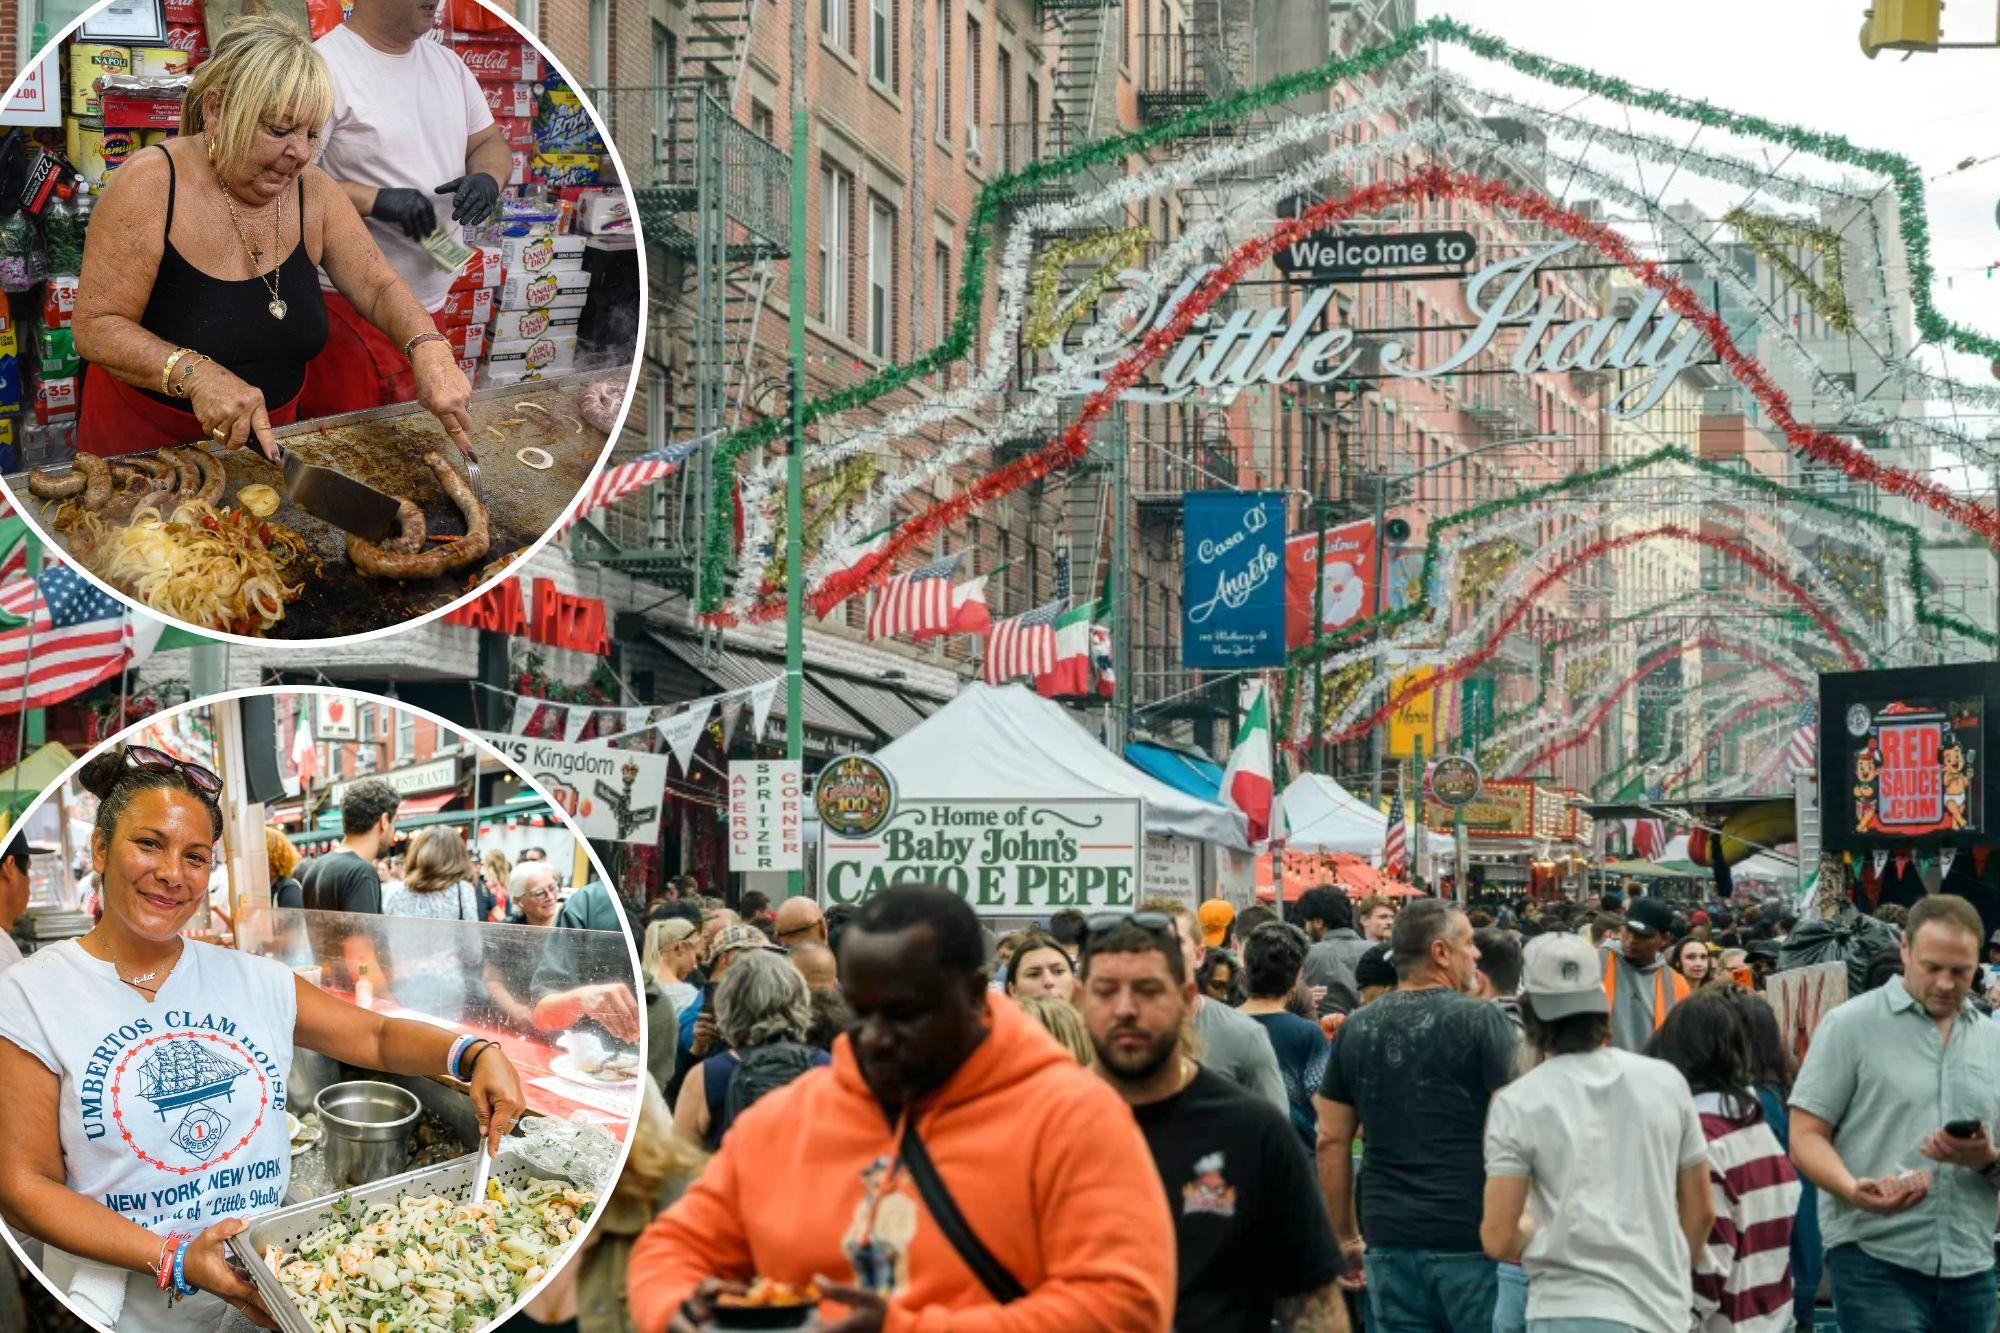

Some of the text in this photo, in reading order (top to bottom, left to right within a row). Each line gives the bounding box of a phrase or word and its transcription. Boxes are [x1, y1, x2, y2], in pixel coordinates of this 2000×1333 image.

[93, 56, 128, 67] NAPOLI
[461, 49, 511, 70] Coca-Cola
[523, 51, 536, 60] 35
[516, 91, 527, 100] 35
[32, 157, 53, 182] 222
[485, 254, 500, 265] 35
[522, 245, 554, 268] CANADA
[530, 255, 546, 268] DRY
[1290, 237, 1466, 267] Welcome to
[475, 291, 490, 302] 35
[526, 282, 558, 301] CANADA
[534, 290, 550, 304] DRY
[518, 313, 550, 333] CANADA
[526, 323, 543, 336] DRY
[1032, 240, 1704, 421] Little Italy
[460, 360, 474, 369] 35
[525, 346, 556, 364] CANADA
[48, 384, 71, 397] 35
[1197, 532, 1245, 564] Casa
[1188, 544, 1279, 623] Angelo
[442, 576, 527, 637] ASTA
[1881, 727, 1940, 769] RED
[533, 745, 615, 776] Kingdom
[1881, 769, 1940, 797] SAUCE
[733, 774, 749, 855] APEROL
[757, 763, 772, 868] SPRITZER
[782, 773, 799, 853] CORNER
[930, 805, 1028, 826] Home of
[1883, 797, 1937, 820] .COM
[883, 828, 1078, 865] Baby John's
[976, 866, 1006, 905] E
[1015, 865, 1134, 905] PEPE
[80, 1010, 285, 1141] UMBERTOS CLAM HOUSE
[181, 1127, 219, 1149] UMBERTOS
[194, 1125, 205, 1139] 1
[105, 1193, 147, 1212] NEW
[207, 1167, 244, 1191] NEW
[247, 1157, 282, 1182] YORK
